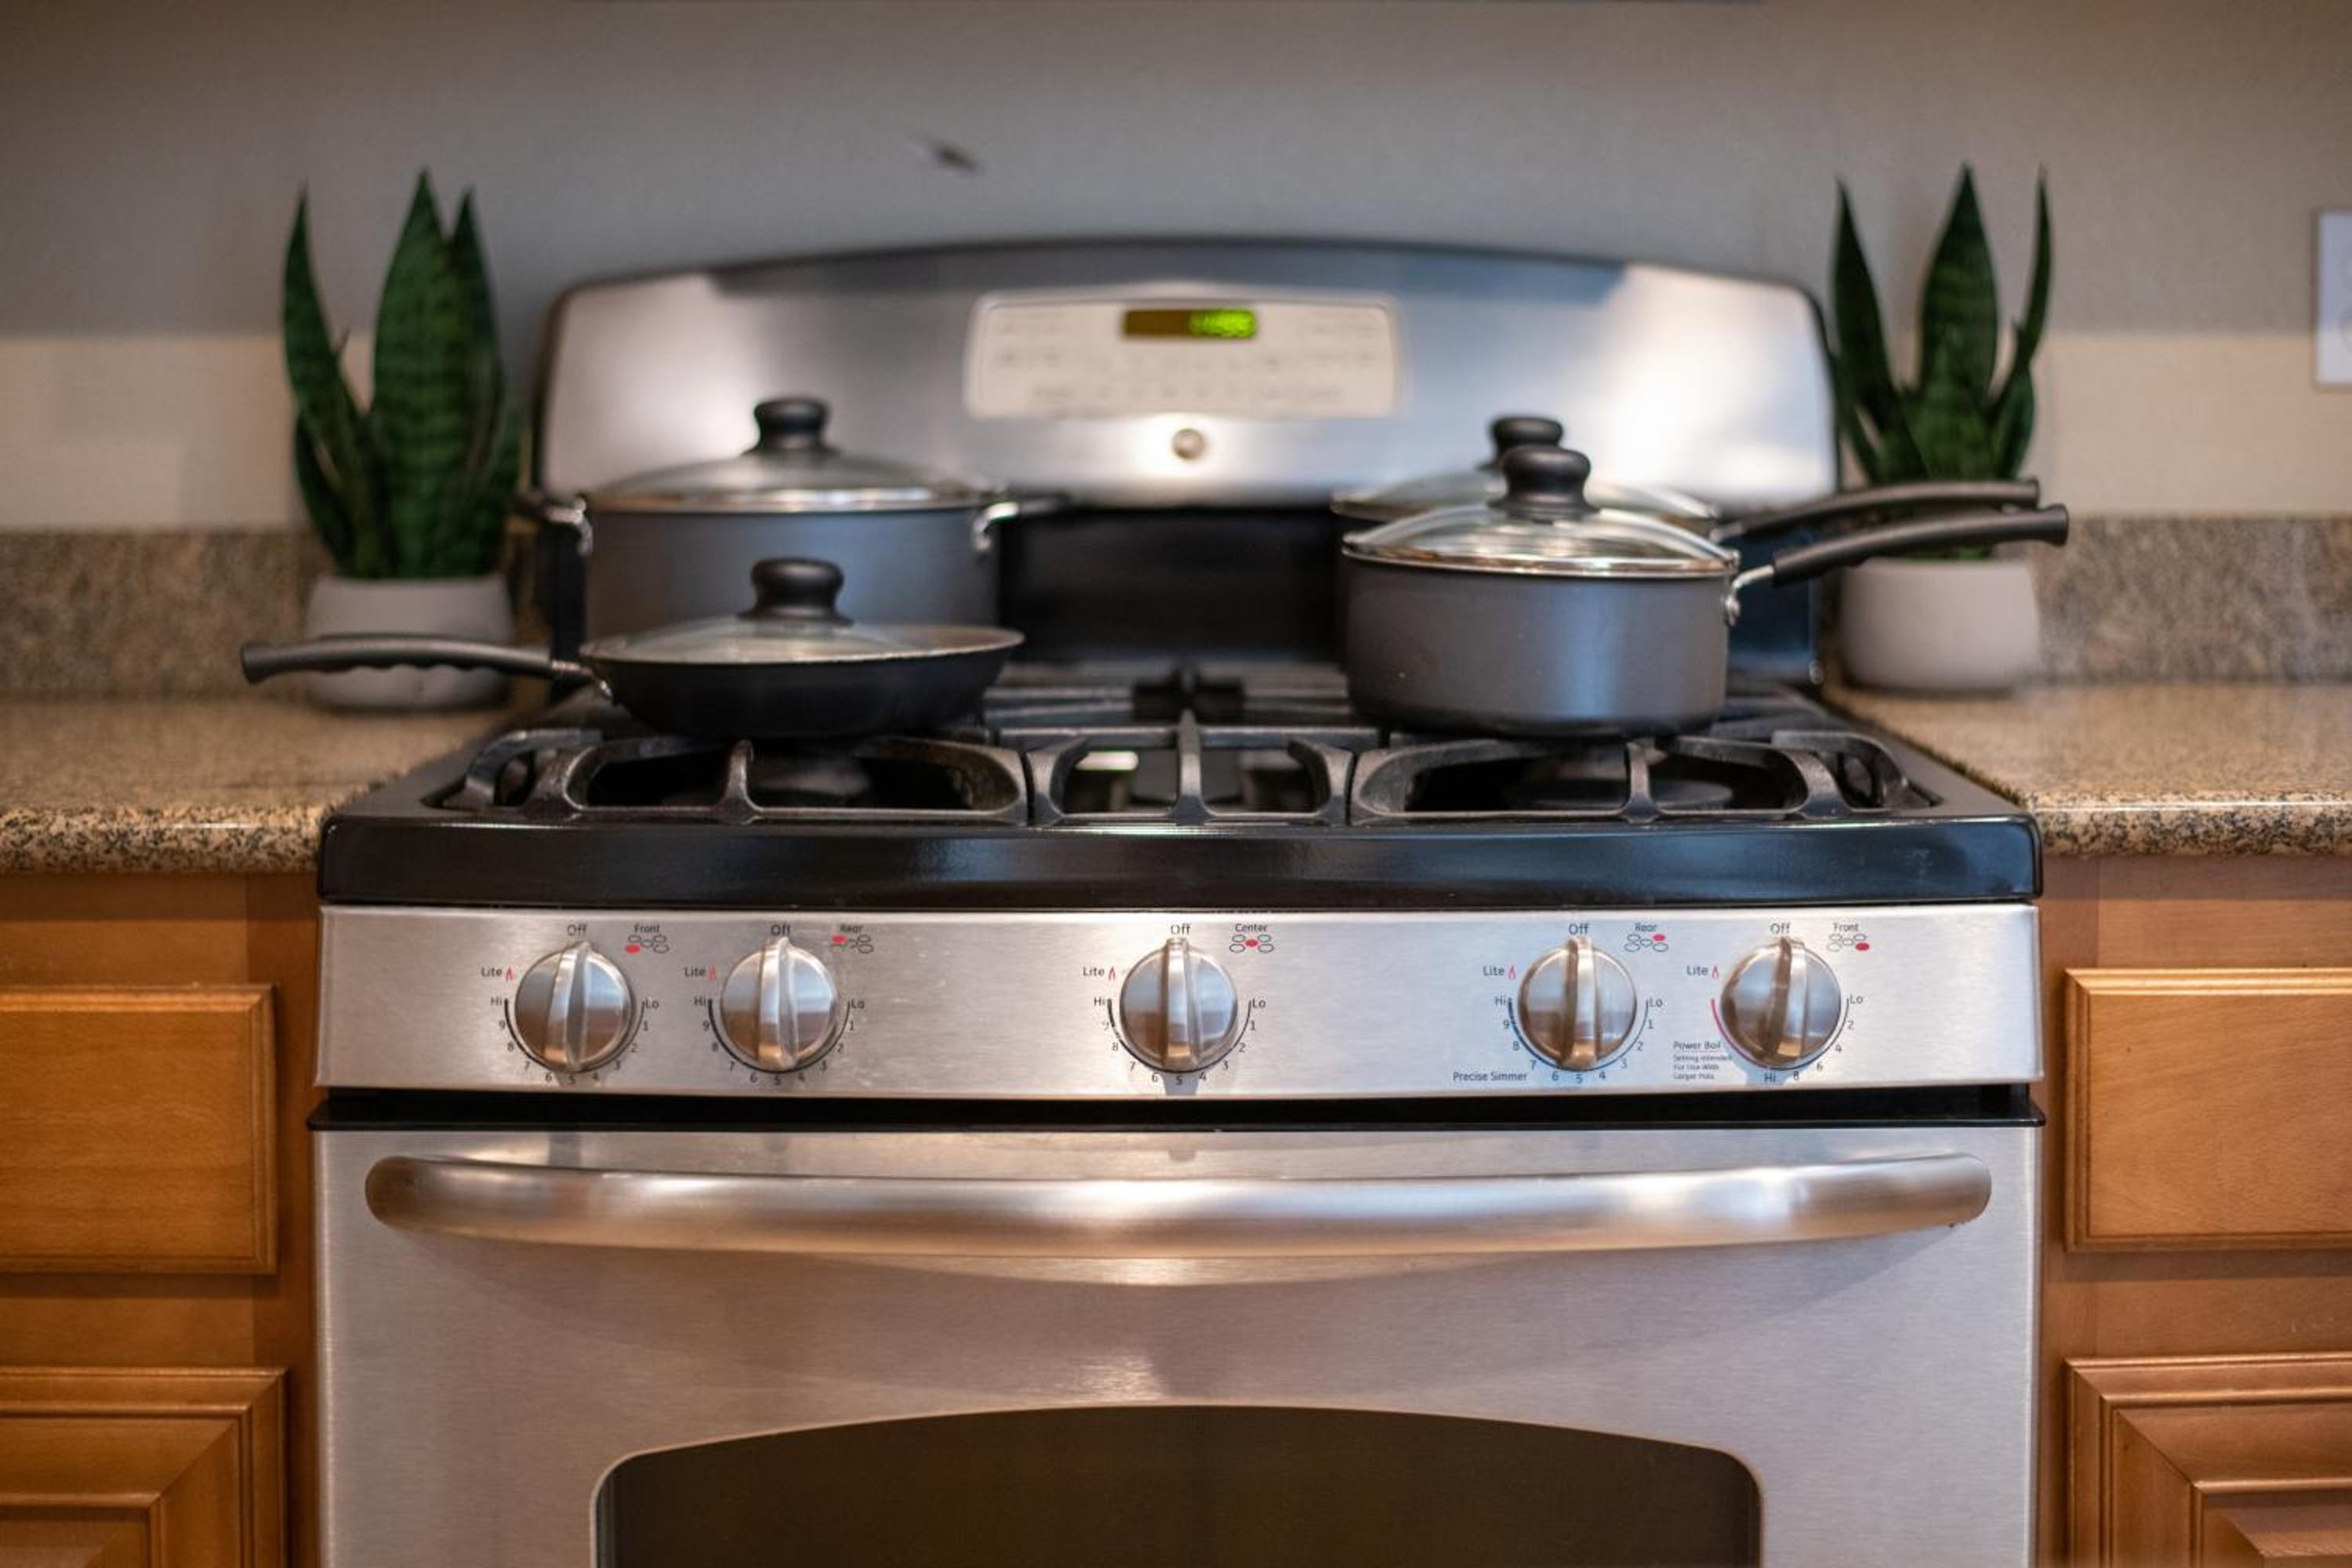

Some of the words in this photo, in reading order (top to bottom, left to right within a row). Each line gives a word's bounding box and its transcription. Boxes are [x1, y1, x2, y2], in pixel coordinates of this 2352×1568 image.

[568, 924, 587, 935] Off
[634, 924, 660, 933] Front
[771, 924, 791, 935] Off
[1171, 924, 1191, 935] Off
[1235, 924, 1268, 932] Center
[1569, 924, 1589, 935] Off
[1635, 923, 1657, 931] Rear
[1770, 924, 1791, 934] Off
[1834, 923, 1860, 932] Front
[481, 968, 502, 977] Lite
[684, 967, 706, 977] Lite
[1083, 967, 1105, 976] Lite
[1483, 967, 1504, 976] Lite
[1686, 966, 1708, 976] Lite
[851, 1000, 865, 1008] Lo
[1094, 997, 1105, 1006] Hi
[1252, 999, 1265, 1007] Lo
[1494, 996, 1506, 1005] Hi
[1650, 999, 1662, 1007] Lo
[499, 1021, 506, 1029] 9
[643, 1022, 648, 1030] 1
[703, 1021, 710, 1030] 9
[849, 1021, 855, 1030] 1
[1250, 1021, 1256, 1030] 1
[1504, 1020, 1509, 1029] 9
[1648, 1020, 1653, 1029] 1
[1848, 1021, 1854, 1029] 2
[508, 1043, 514, 1051] 8
[631, 1044, 638, 1052] 2
[712, 1043, 718, 1052] 8
[837, 1044, 844, 1053] 2
[1112, 1043, 1118, 1051] 8
[1239, 1044, 1246, 1052] 2
[1513, 1042, 1519, 1051] 8
[1673, 1041, 1701, 1050] Power
[1704, 1041, 1721, 1050] Boil
[1835, 1044, 1842, 1053] 4
[729, 1062, 735, 1071] 7
[1130, 1062, 1135, 1070] 7
[1223, 1061, 1229, 1070] 3
[1530, 1059, 1537, 1069] 7
[1621, 1059, 1628, 1069] 3
[1817, 1062, 1823, 1071] 6
[546, 1073, 552, 1082] 6
[592, 1073, 599, 1081] 4
[750, 1073, 757, 1082] 6
[798, 1073, 805, 1081] 4
[1152, 1073, 1159, 1082] 6
[1454, 1072, 1488, 1081] Precise
[1490, 1072, 1527, 1081] Simmer
[1552, 1071, 1559, 1080] 6
[1577, 1074, 1583, 1083] 5
[1599, 1070, 1606, 1079] 4
[1765, 1073, 1776, 1082] Hi
[1794, 1071, 1799, 1080] 8
[569, 1075, 575, 1084] 5
[775, 1075, 781, 1085] 5
[1176, 1076, 1182, 1085] 5
